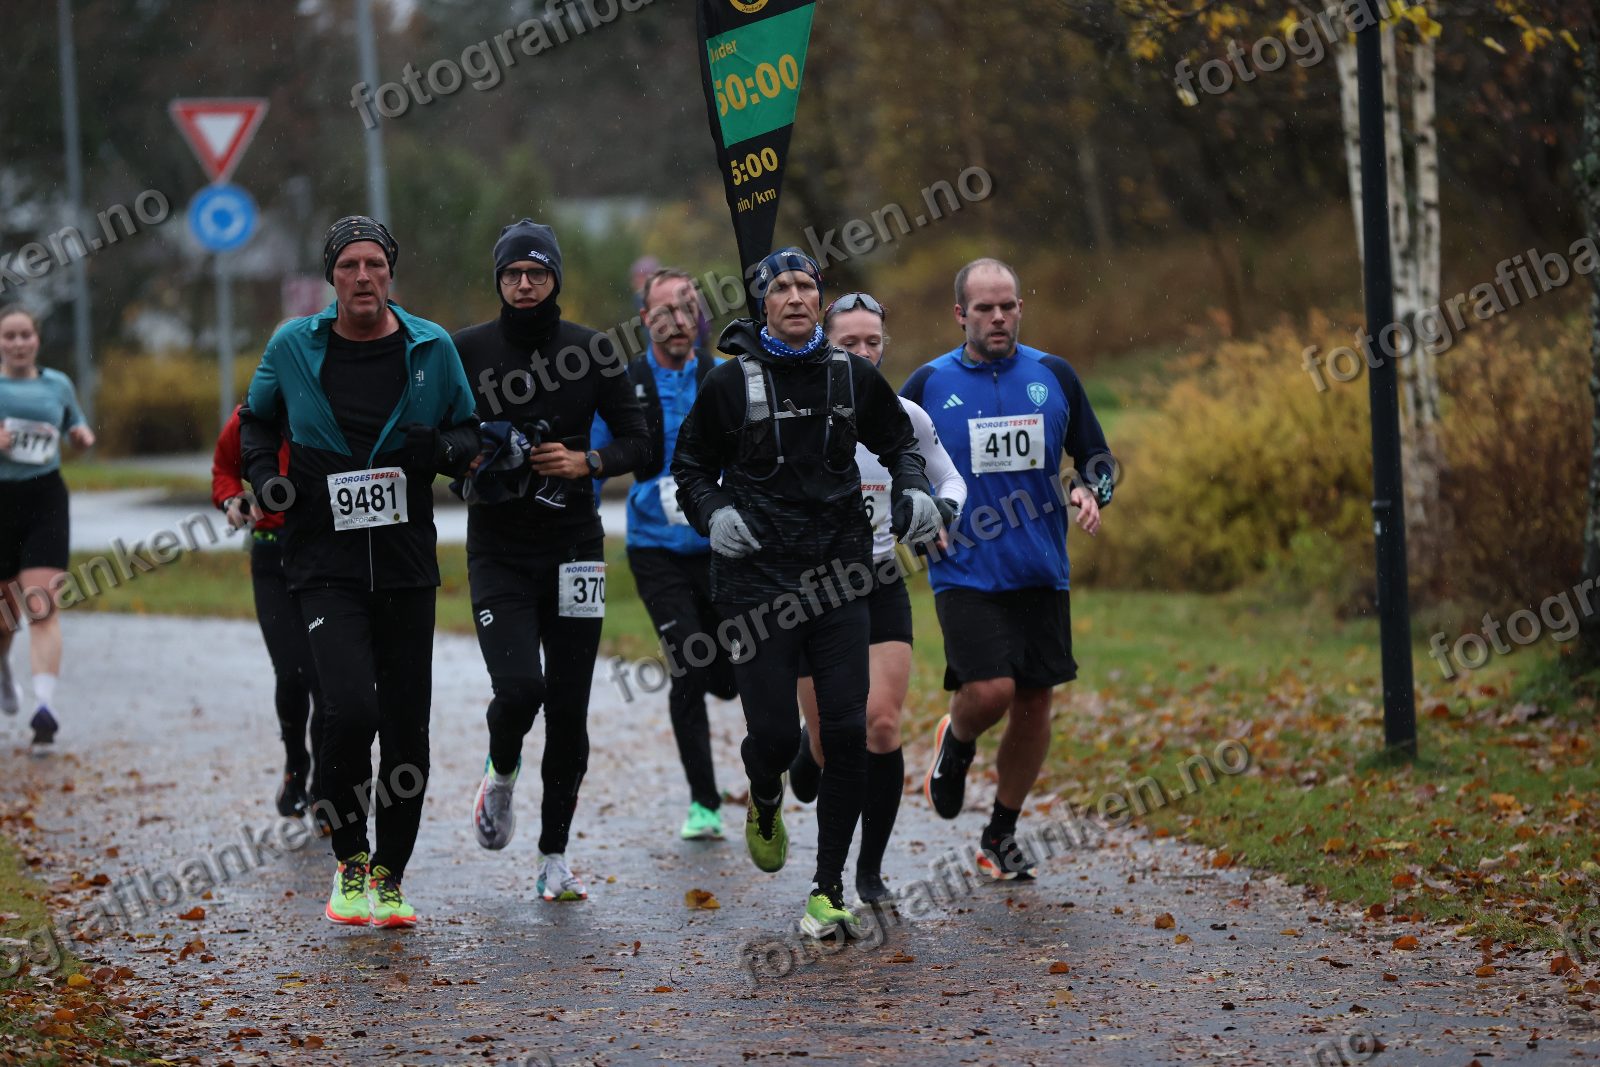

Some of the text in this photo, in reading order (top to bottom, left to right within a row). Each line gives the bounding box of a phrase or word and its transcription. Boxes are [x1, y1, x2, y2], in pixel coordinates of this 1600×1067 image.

[730, 147, 779, 186] 5:00
[975, 418, 1038, 430] NORGESTESTEN
[985, 429, 1031, 458] 410
[337, 482, 397, 516] 9481
[860, 484, 886, 492] ESTEN
